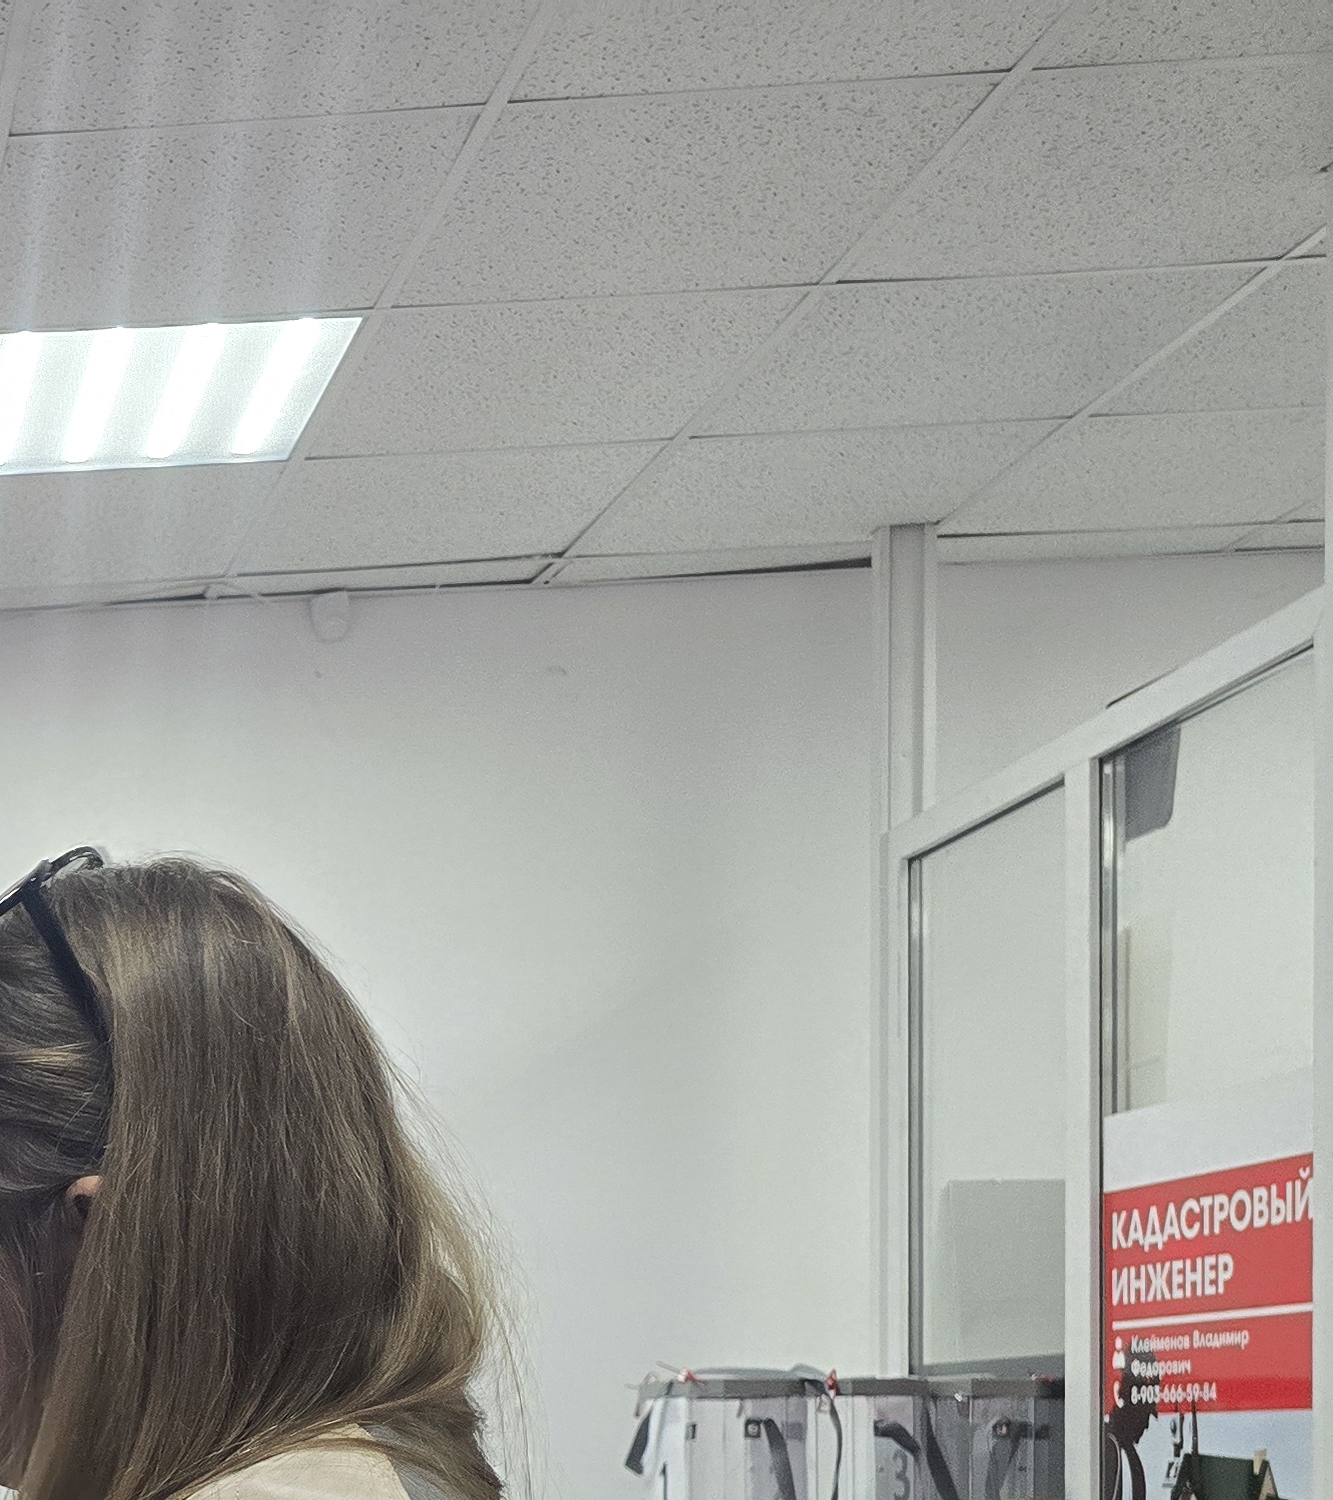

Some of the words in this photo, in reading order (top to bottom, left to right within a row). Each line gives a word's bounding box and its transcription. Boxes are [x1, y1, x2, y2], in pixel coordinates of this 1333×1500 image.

[1111, 1166, 1313, 1252] КАДАСТРОВЫЙ
[1111, 1253, 1234, 1306] ИНЖЕНЕР
[1193, 1329, 1249, 1350] Владимир
